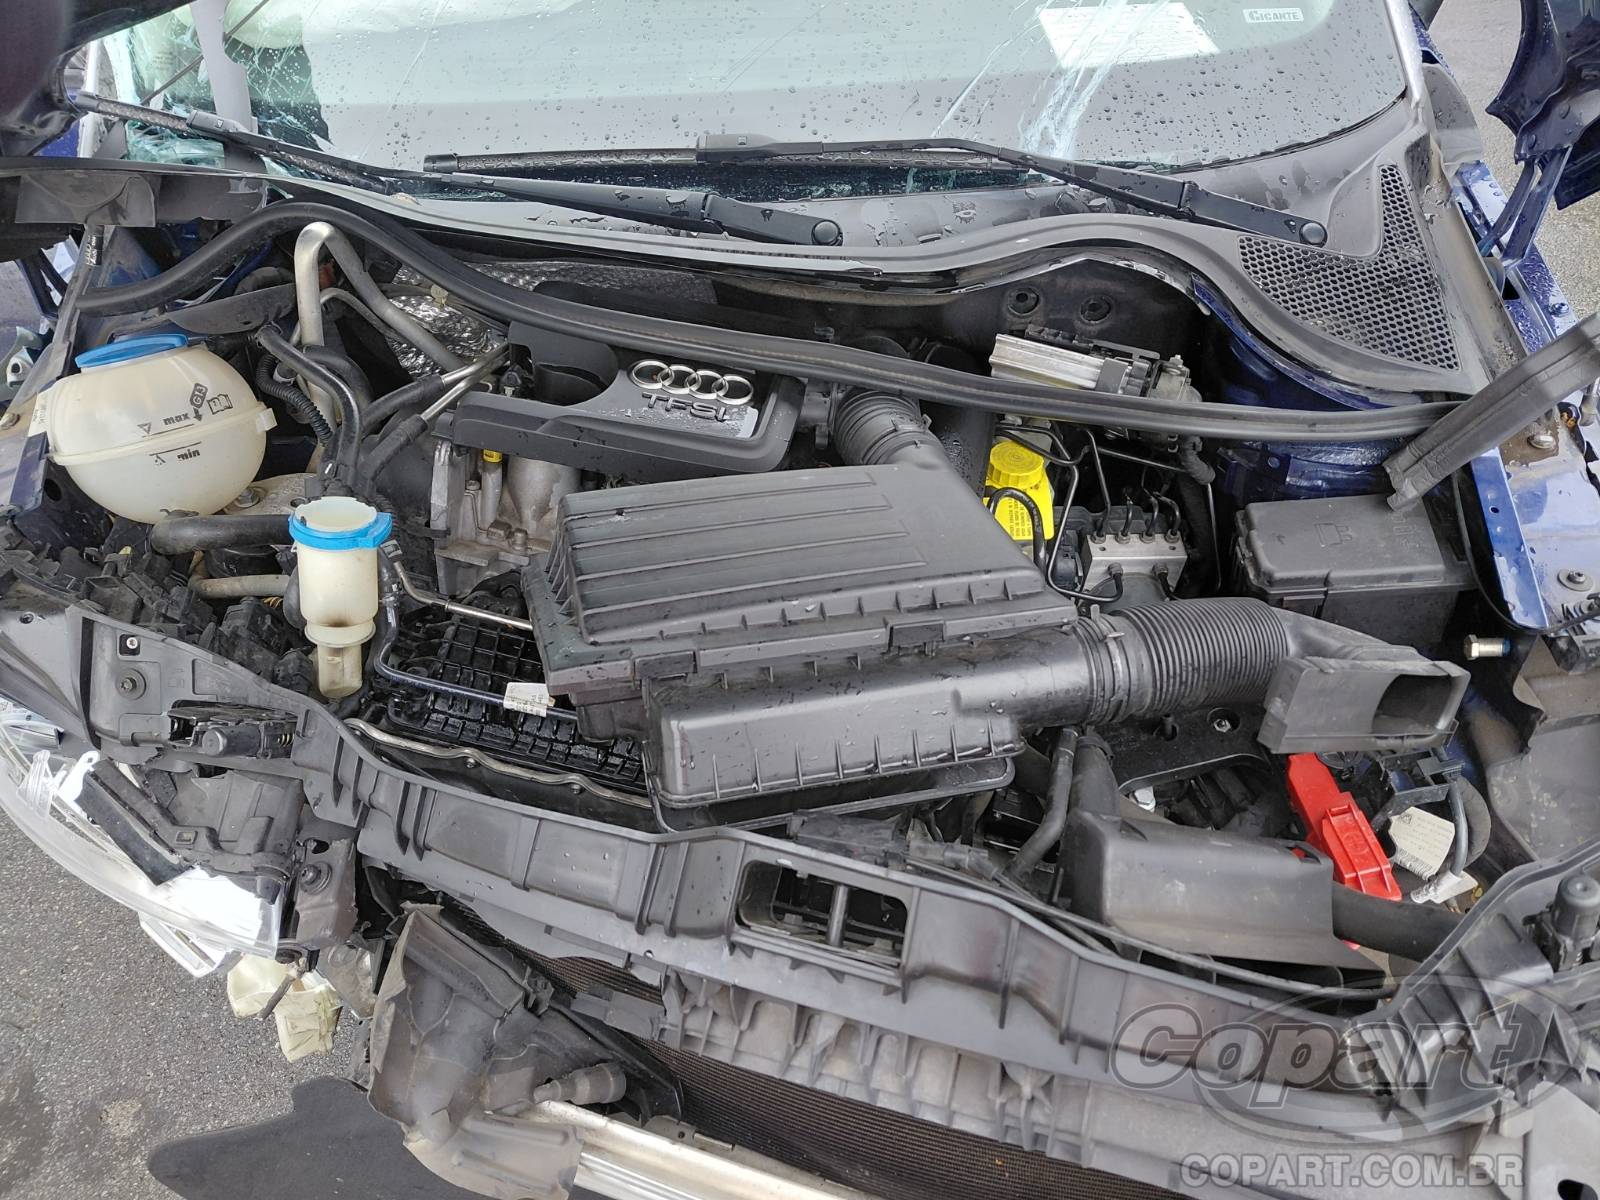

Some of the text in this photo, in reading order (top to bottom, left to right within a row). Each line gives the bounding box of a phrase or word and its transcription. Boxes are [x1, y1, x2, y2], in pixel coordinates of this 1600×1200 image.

[642, 391, 727, 423] TFSI
[163, 412, 191, 426] max
[177, 448, 201, 461] min
